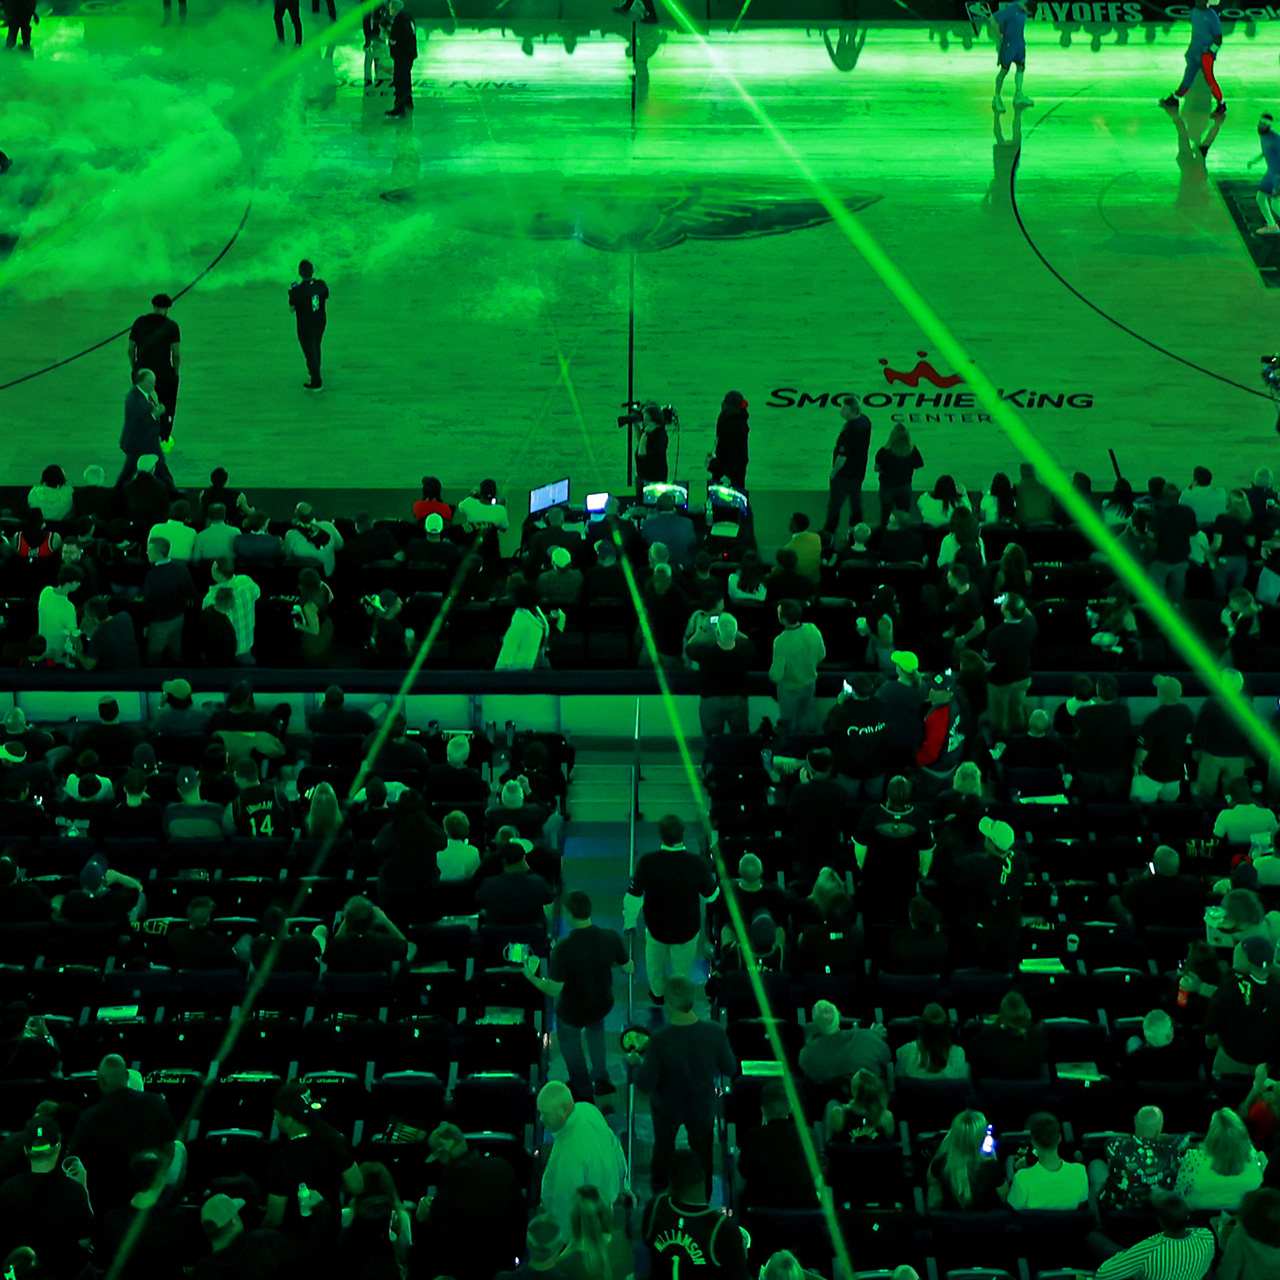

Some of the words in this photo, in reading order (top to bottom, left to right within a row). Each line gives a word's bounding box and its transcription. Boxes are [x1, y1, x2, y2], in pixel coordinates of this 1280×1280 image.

[890, 413, 993, 424] CENTER
[249, 814, 274, 837] 14
[653, 1227, 706, 1266] WILLIAMSON
